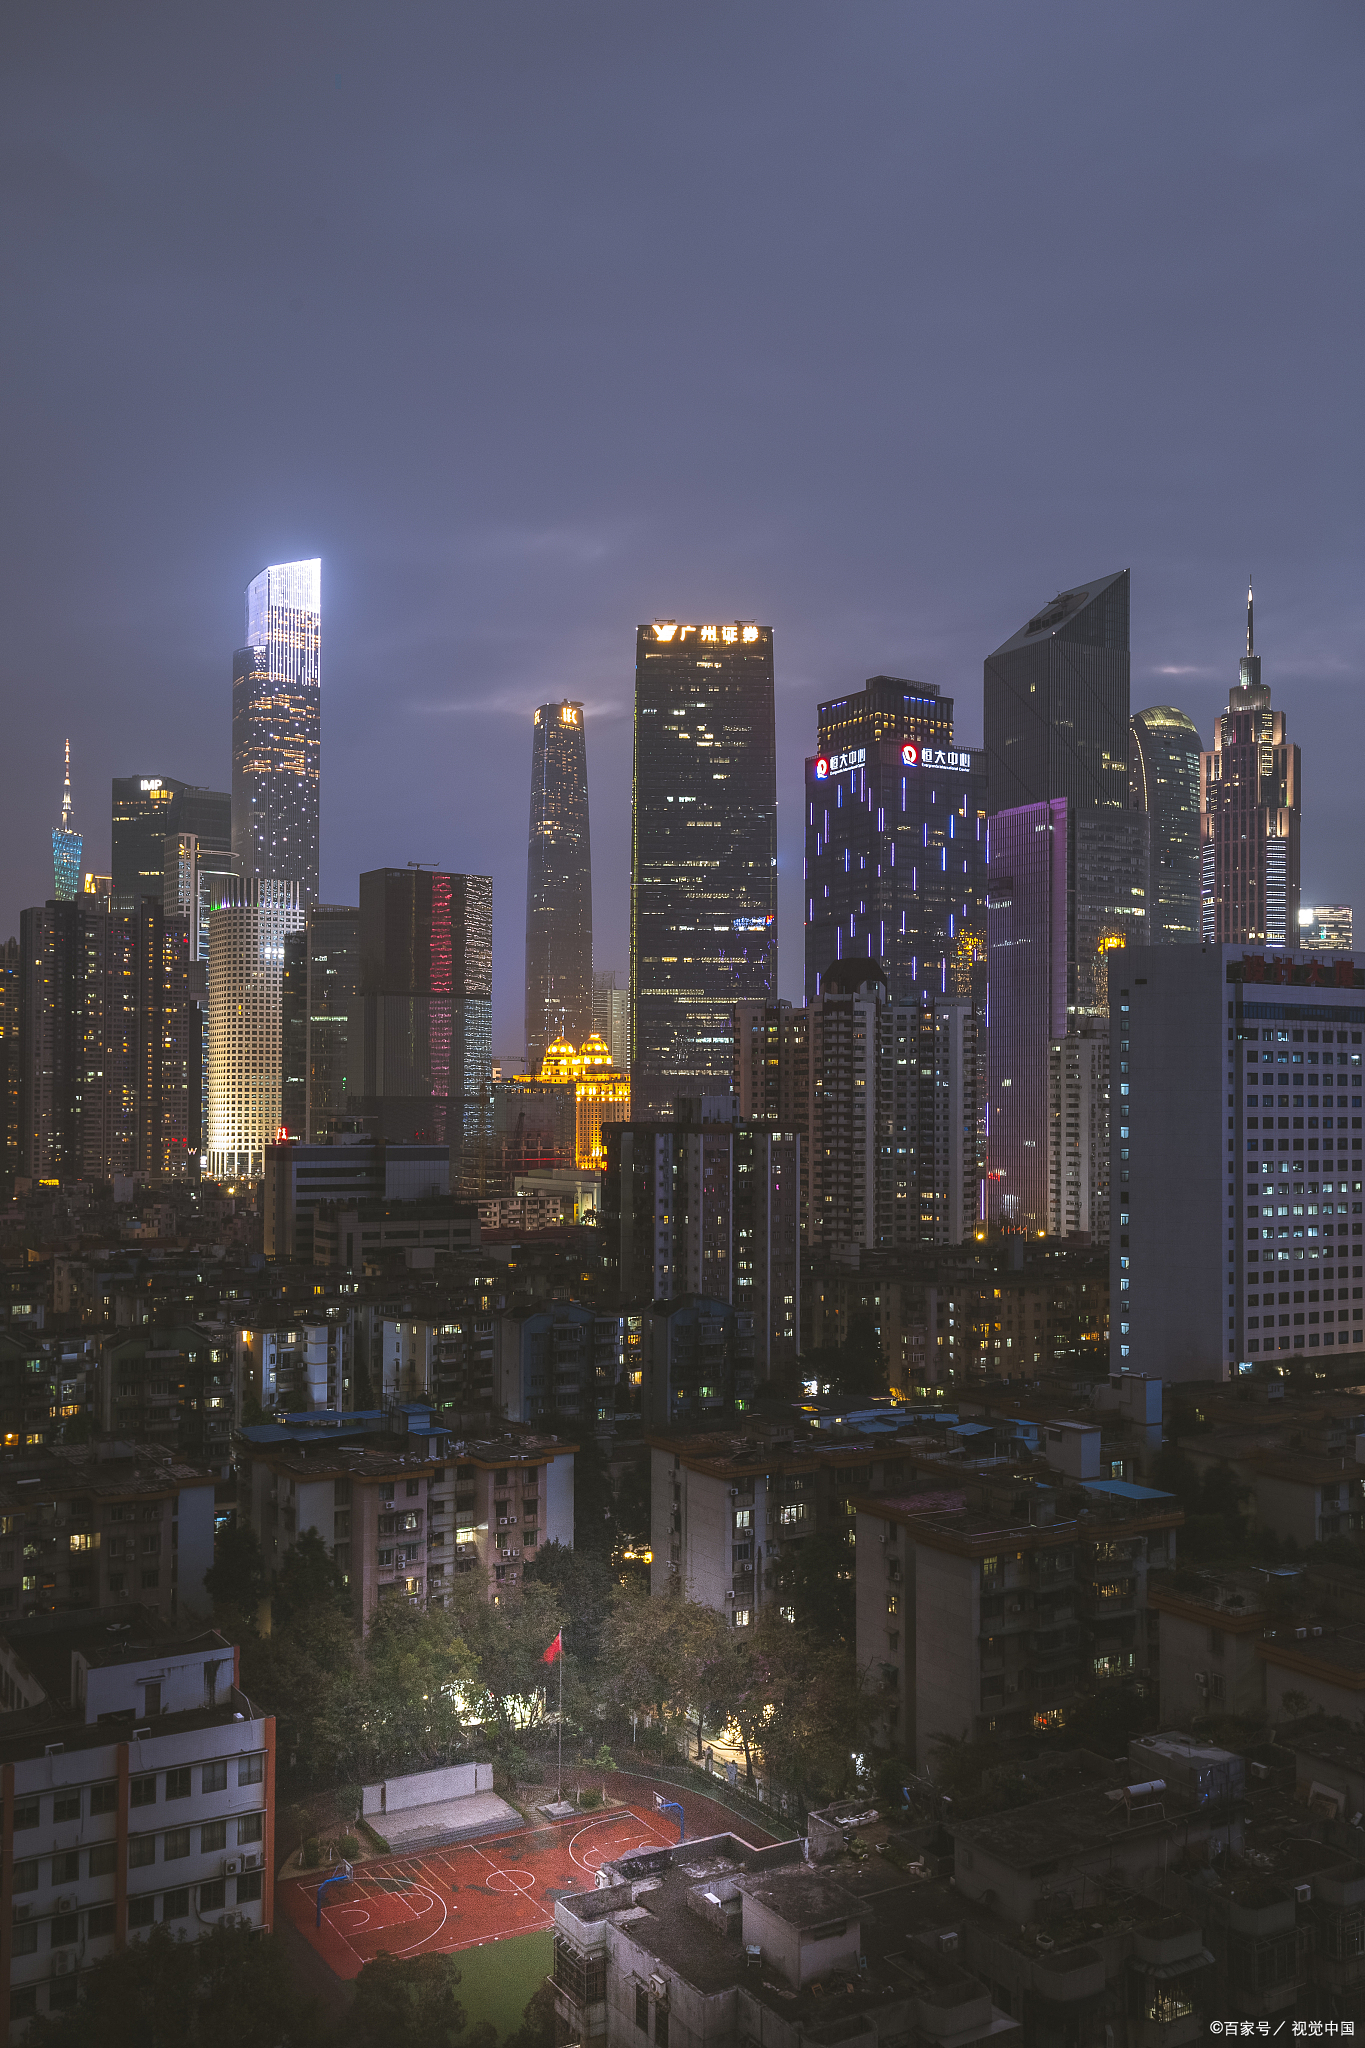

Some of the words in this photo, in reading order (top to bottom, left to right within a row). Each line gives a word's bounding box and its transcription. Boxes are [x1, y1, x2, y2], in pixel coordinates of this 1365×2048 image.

[680, 626, 759, 641] 广州证券
[829, 748, 866, 770] 恒大中心
[921, 747, 970, 768] 恒大中心
[140, 779, 163, 791] IMP
[1242, 955, 1354, 987] 设计大厦
